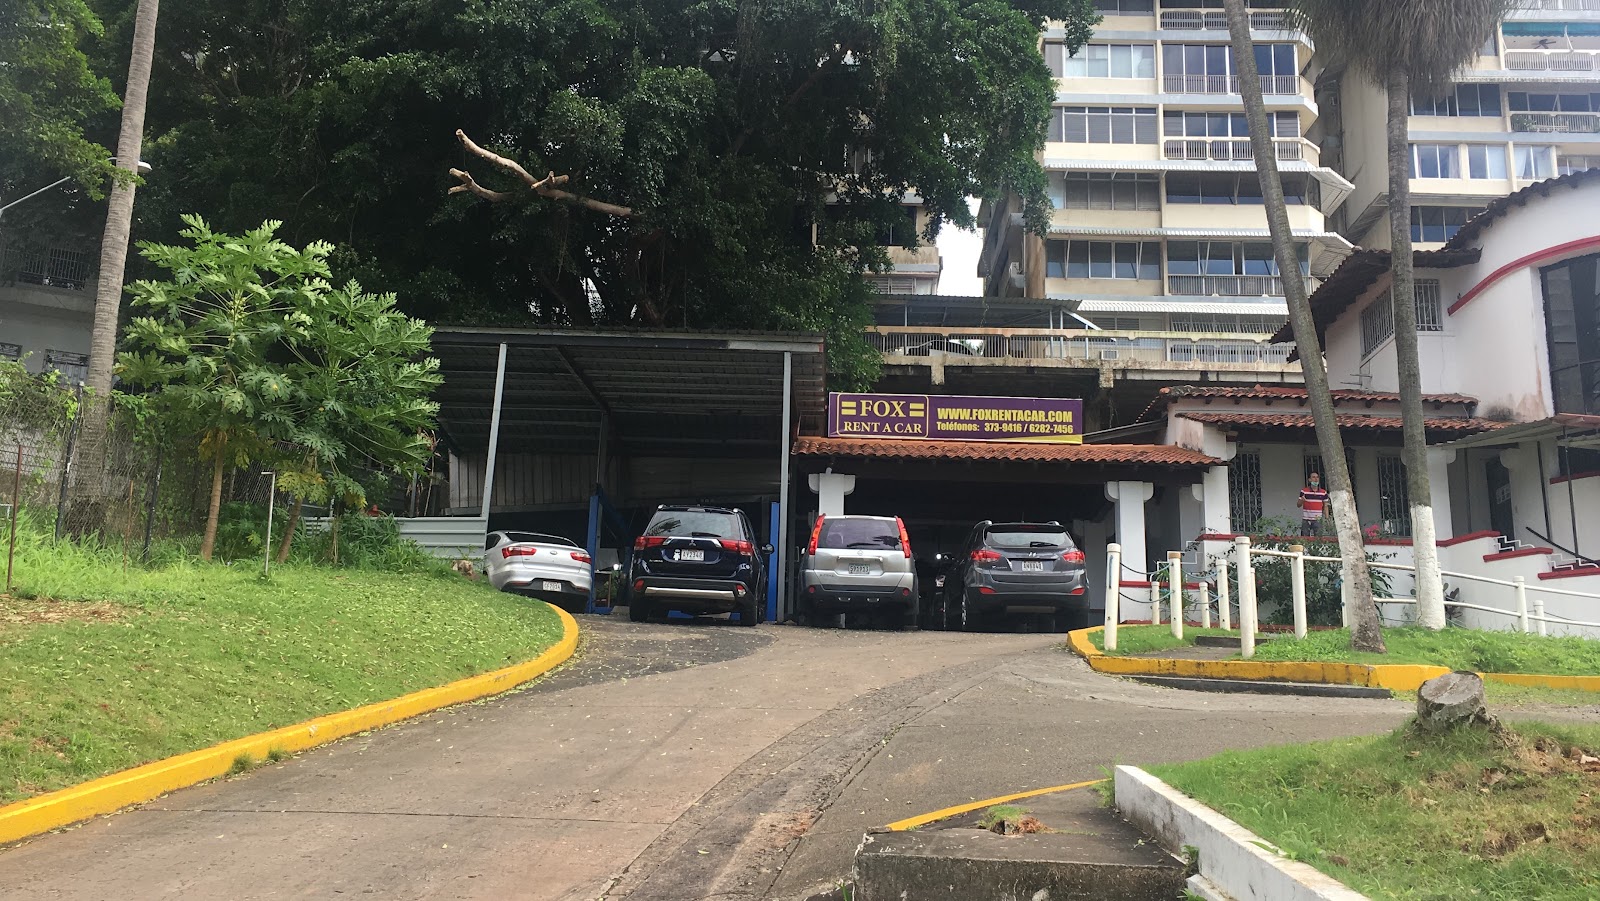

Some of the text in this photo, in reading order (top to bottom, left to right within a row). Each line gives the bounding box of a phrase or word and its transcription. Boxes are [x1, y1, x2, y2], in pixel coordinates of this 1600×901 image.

[860, 400, 906, 417] FOX
[937, 408, 1073, 423] WWW.FOXRENTACAR.COM
[844, 421, 922, 433] RENT A CAR
[936, 421, 1073, 434] Teléfonos: 373-9416 / 6282-7456
